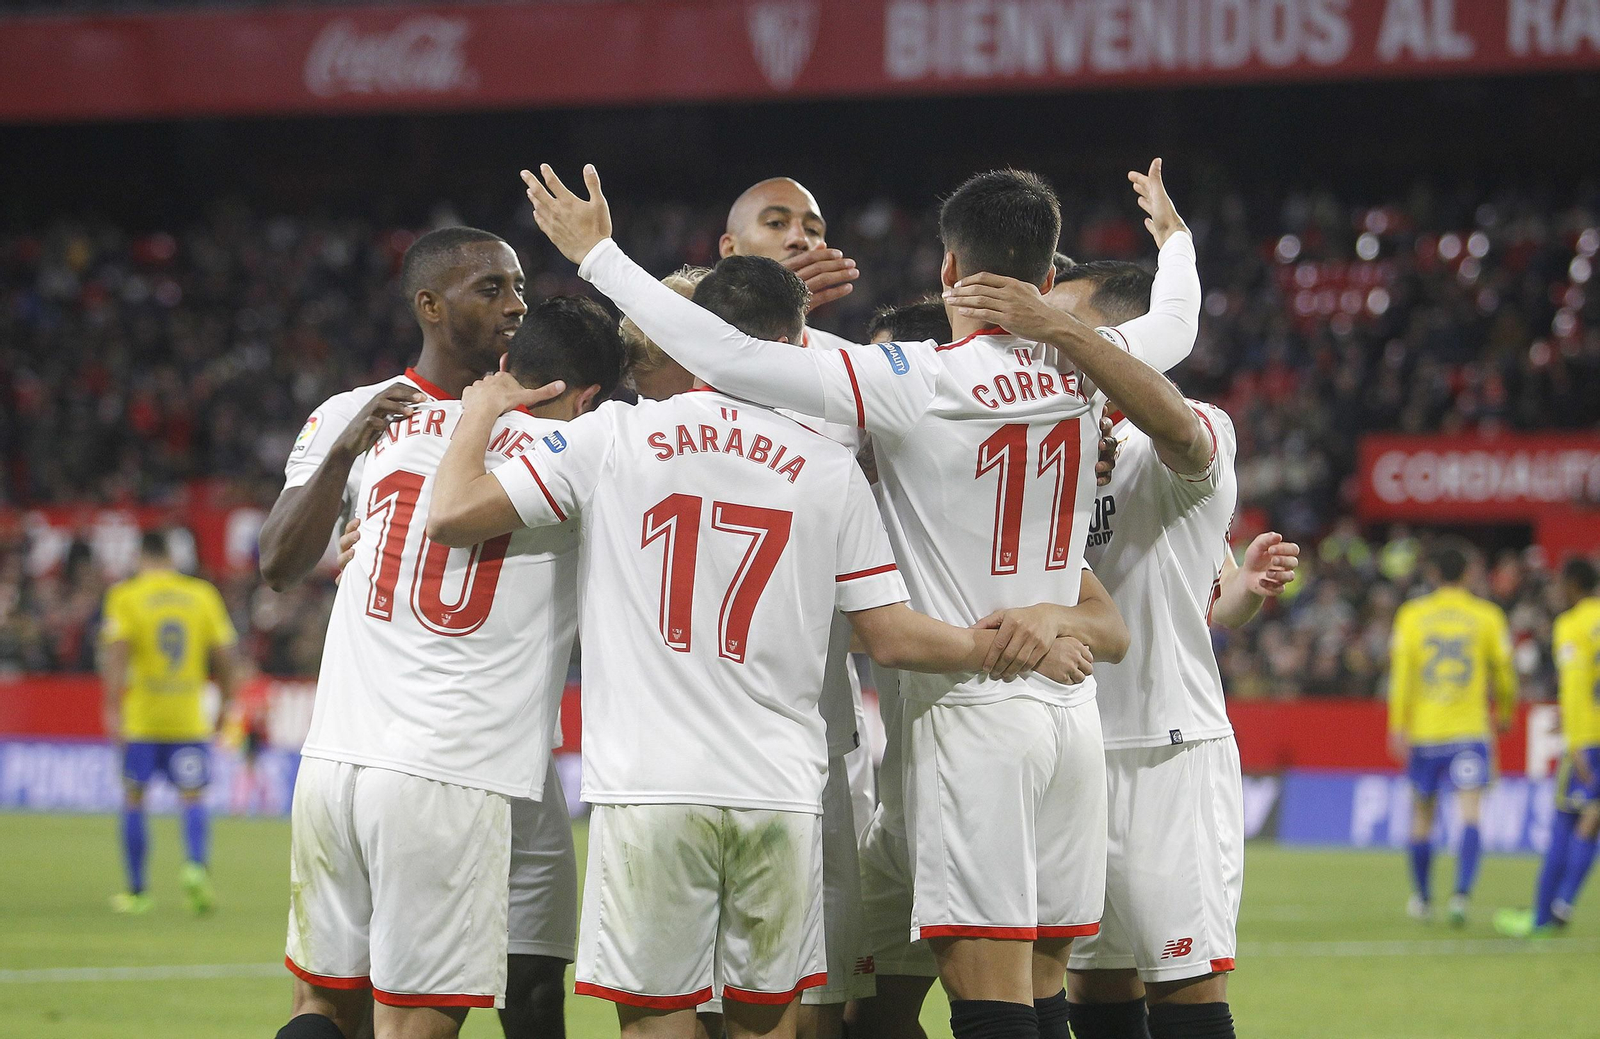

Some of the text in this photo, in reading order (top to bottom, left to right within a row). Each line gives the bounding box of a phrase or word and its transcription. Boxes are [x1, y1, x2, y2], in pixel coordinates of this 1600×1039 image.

[884, 0, 1350, 80] BIENVENIDOS
[1376, 0, 1474, 63] AL
[646, 423, 807, 485] SARABIA
[974, 417, 1082, 576] 11
[365, 469, 511, 638] 10
[640, 492, 794, 665] 17
[157, 617, 188, 672] 9
[1422, 634, 1475, 687] 25
